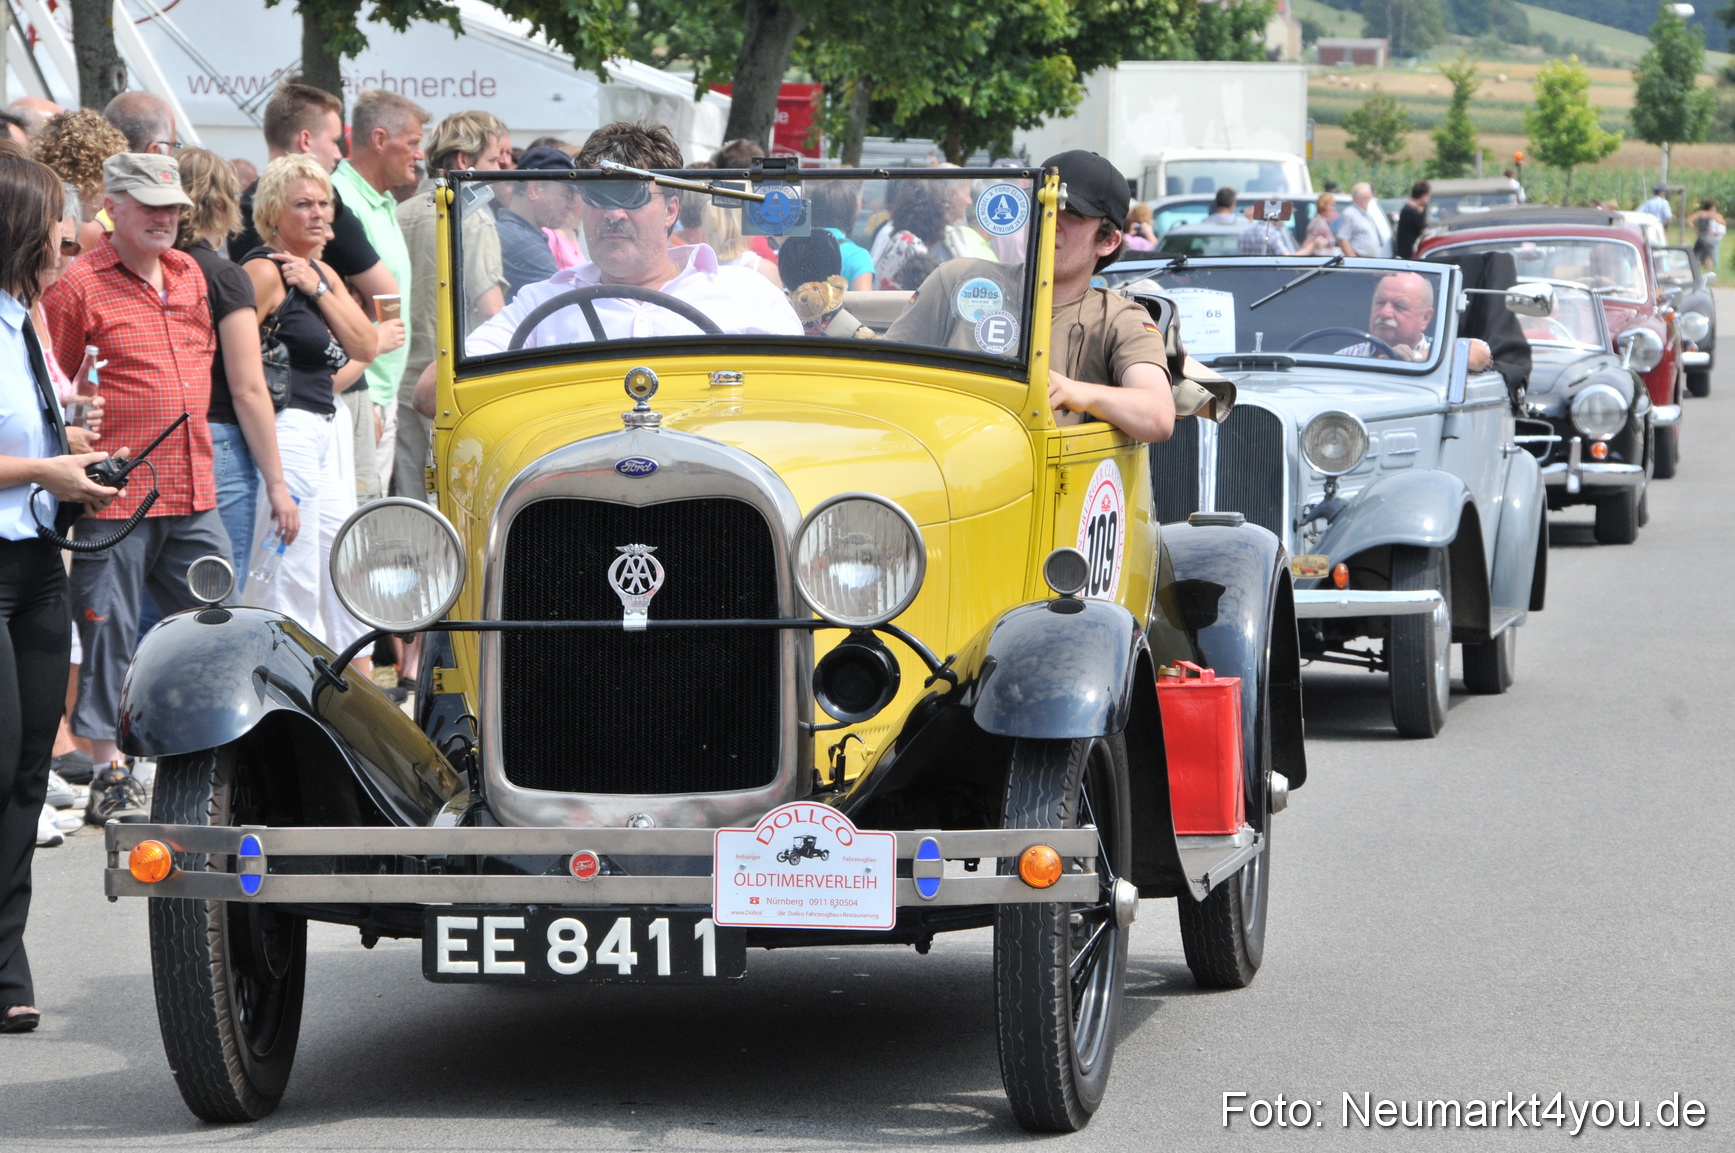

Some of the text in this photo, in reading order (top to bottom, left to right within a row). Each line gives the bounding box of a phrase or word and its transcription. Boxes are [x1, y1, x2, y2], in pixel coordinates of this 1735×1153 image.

[1011, 189, 1022, 202] CLUB
[980, 197, 989, 216] MODEL
[991, 195, 1014, 220] A
[1015, 209, 1026, 226] GREAT
[972, 287, 988, 298] 09
[1206, 310, 1222, 318] 68
[988, 320, 1007, 343] E
[621, 460, 652, 473] Ford
[1085, 511, 1117, 597] 109
[756, 809, 853, 847] DOLLCO
[735, 853, 877, 864] Anhänger Fahrzeugbau
[734, 872, 878, 889] OLDTIMERVERLEIH
[766, 897, 858, 907] Nürnberg 0911 830504
[437, 916, 717, 977] EE 8411
